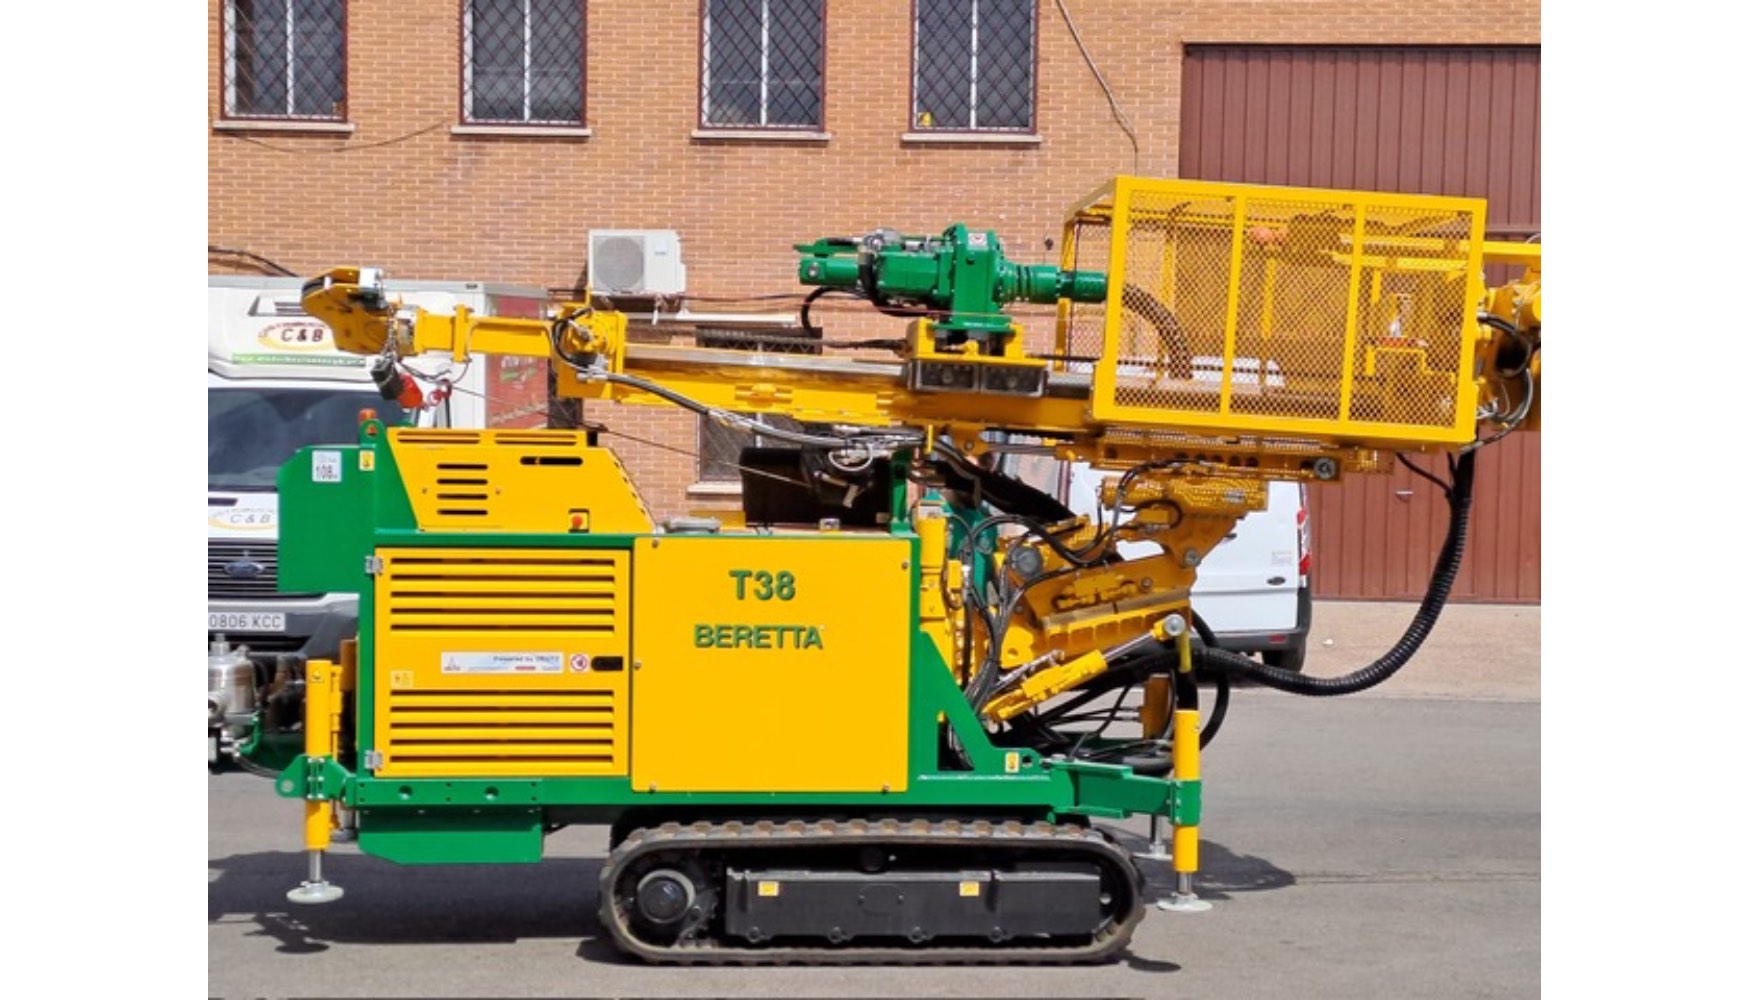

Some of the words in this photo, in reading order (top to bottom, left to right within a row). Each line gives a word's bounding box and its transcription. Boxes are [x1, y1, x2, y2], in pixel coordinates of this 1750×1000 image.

[281, 329, 292, 342] C
[296, 329, 307, 342] &
[311, 329, 323, 342] B
[729, 570, 796, 601] T38
[209, 614, 248, 628] 0806
[252, 614, 282, 628] KCC
[694, 624, 823, 649] BERETTA
